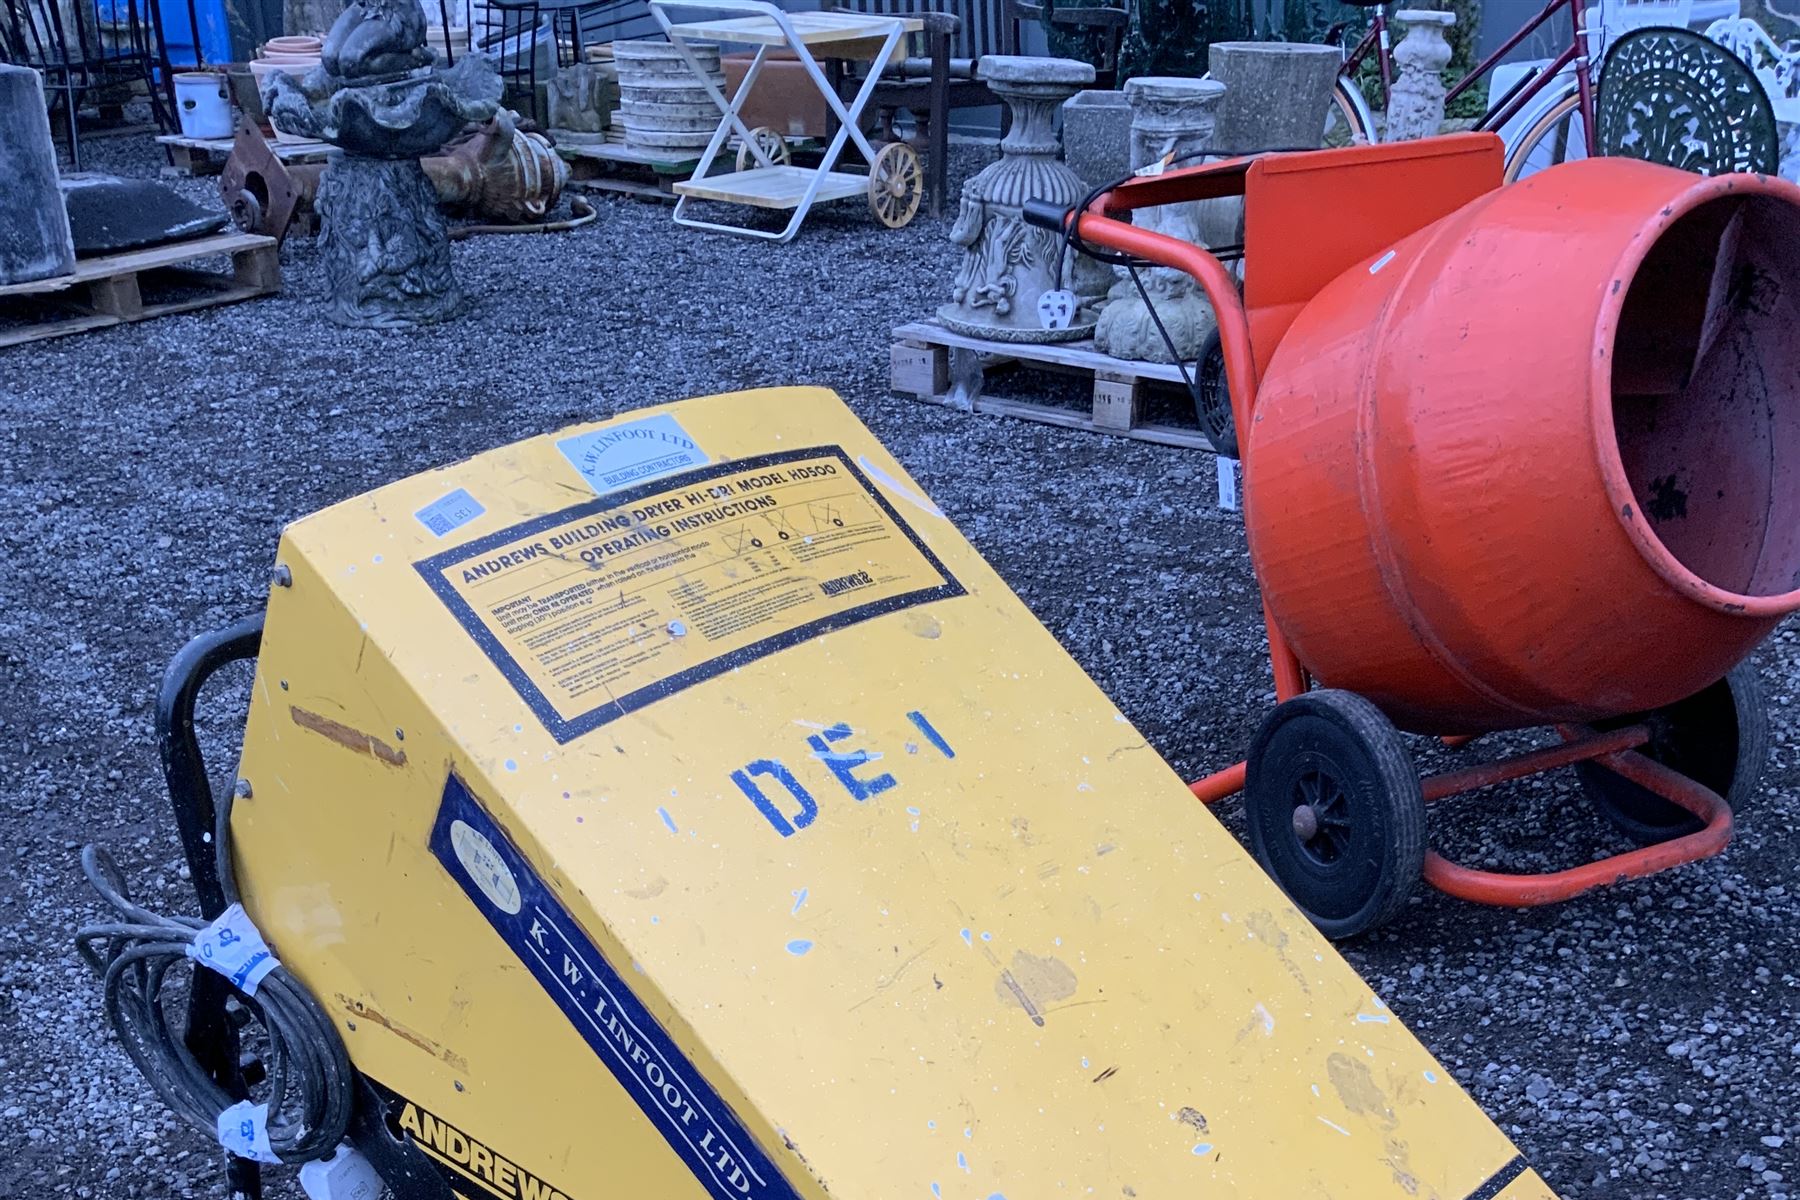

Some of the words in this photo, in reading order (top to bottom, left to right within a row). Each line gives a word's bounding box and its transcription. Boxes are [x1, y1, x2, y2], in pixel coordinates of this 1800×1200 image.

[661, 432, 695, 450] LTD
[603, 467, 638, 485] BUILDING
[640, 454, 692, 475] CONTRACTORS
[462, 543, 549, 584] ANDREWS
[549, 515, 632, 551] BUILDING
[632, 498, 684, 522] DRYER
[684, 483, 734, 508] HI-DRI
[736, 472, 788, 493] MODEL
[786, 464, 837, 481] HD500
[580, 525, 671, 562] OPERATING
[672, 495, 777, 533] INSTRUCTIONS
[491, 595, 532, 616] IMPORTANT
[532, 605, 551, 616] ONLY
[560, 588, 594, 605] OPERATED
[537, 583, 586, 605] TRANSPORTED
[529, 917, 551, 955] K.
[562, 953, 586, 997] W.
[593, 996, 699, 1126] LINFOOT
